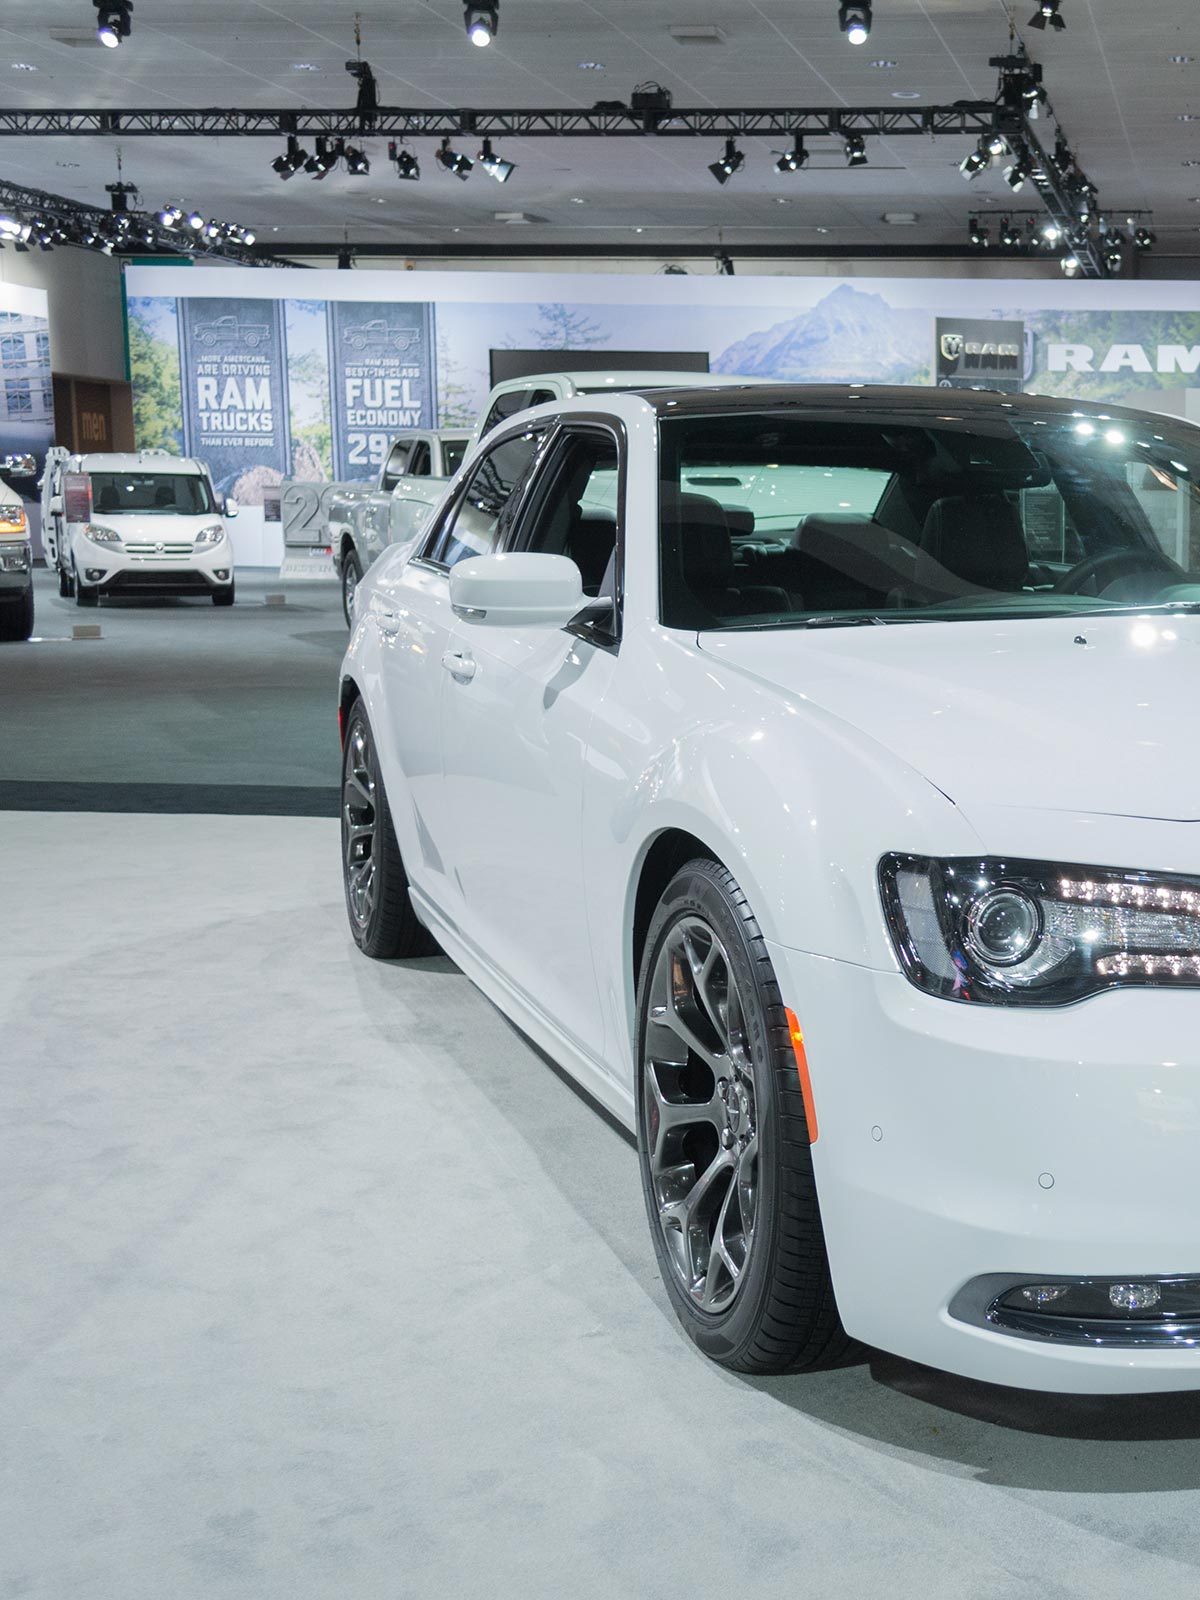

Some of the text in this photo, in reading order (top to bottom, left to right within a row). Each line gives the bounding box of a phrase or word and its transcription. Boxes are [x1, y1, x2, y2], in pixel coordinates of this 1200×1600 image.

[965, 342, 1019, 356] RAM
[197, 364, 271, 376] ARE DRIVING
[345, 367, 420, 378] BEST-IN-CLASS
[197, 377, 272, 410] RAM
[345, 378, 421, 408] FUEL
[82, 411, 107, 441] men
[199, 412, 273, 432] TRUCKS
[346, 409, 422, 426] ECONOMY
[201, 437, 275, 447] THAN EVER BEFORE
[347, 433, 388, 465] 29
